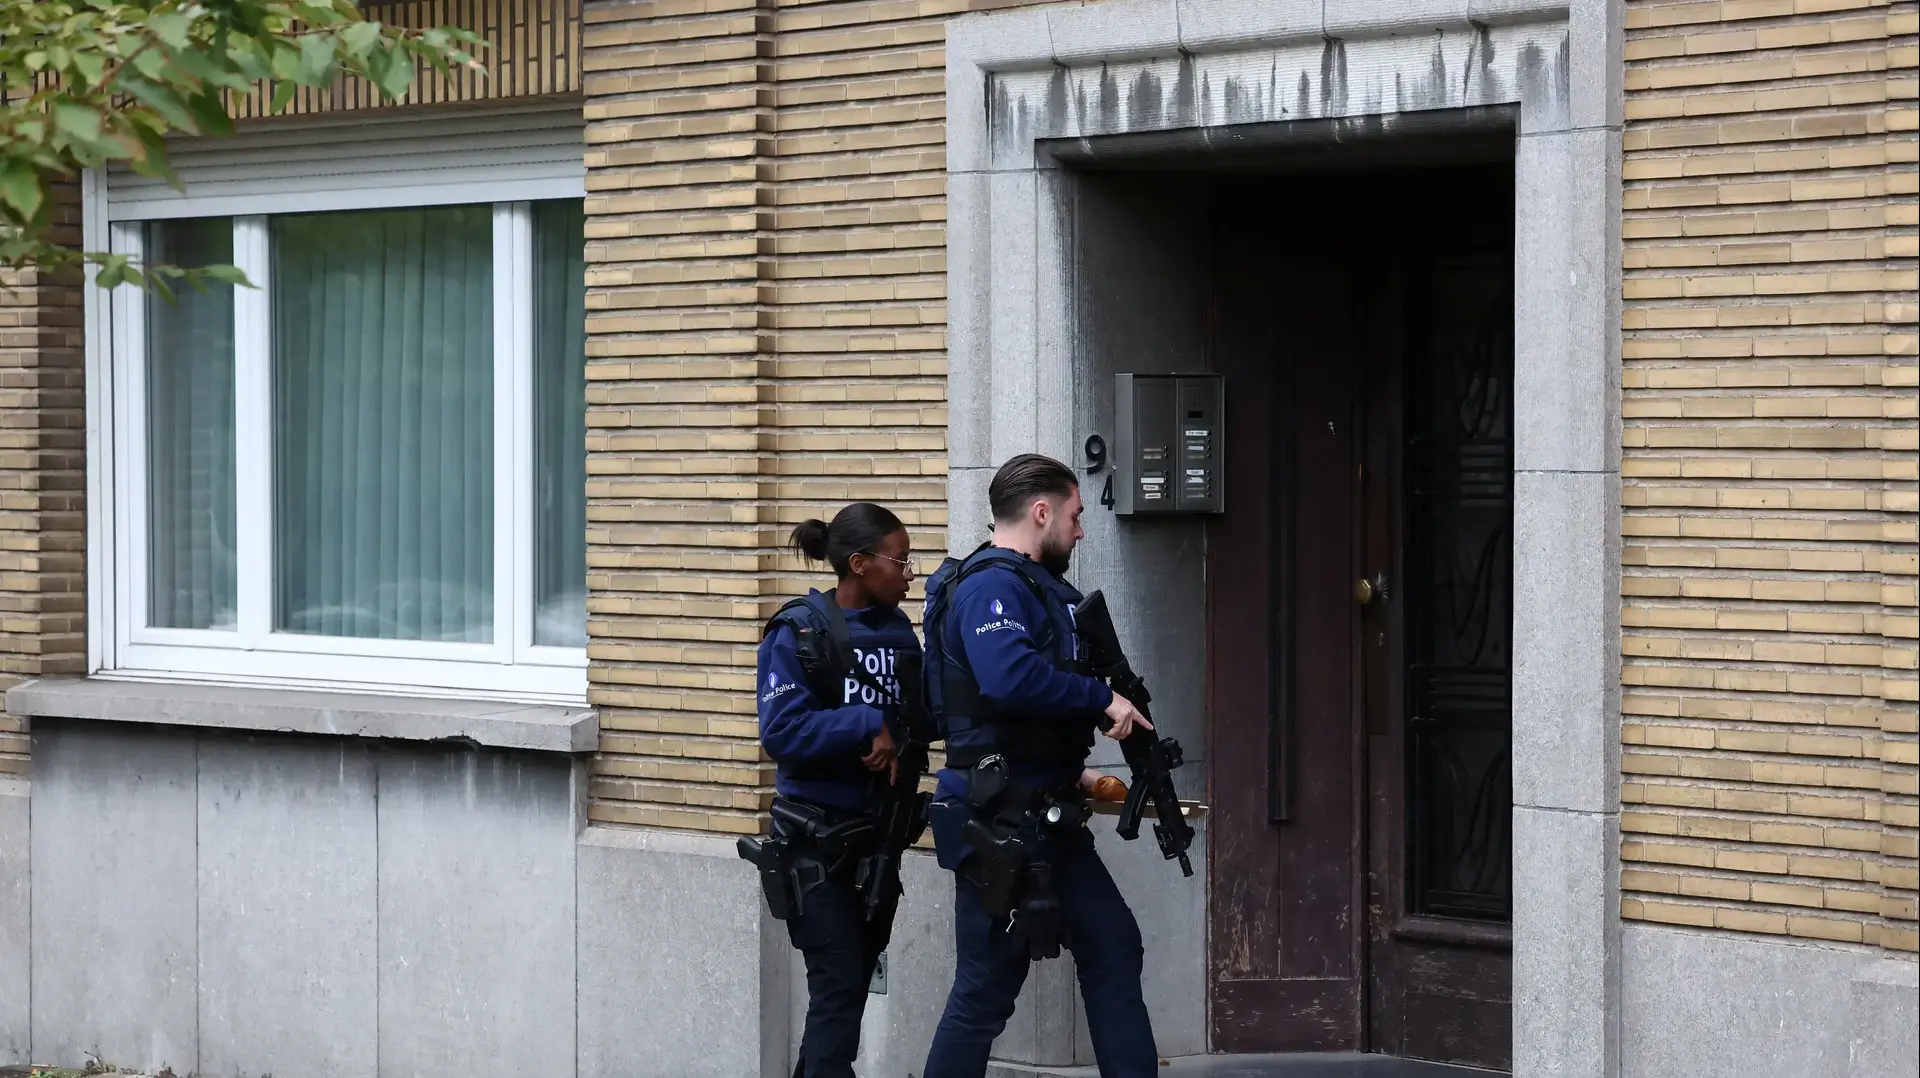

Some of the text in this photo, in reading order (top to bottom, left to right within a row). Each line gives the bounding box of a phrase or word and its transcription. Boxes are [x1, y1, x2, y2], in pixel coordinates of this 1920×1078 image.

[1085, 435, 1107, 474] 9
[1101, 474, 1115, 511] 4
[976, 621, 1001, 635] Police
[775, 683, 796, 694] Police
[844, 676, 901, 705] Polit
